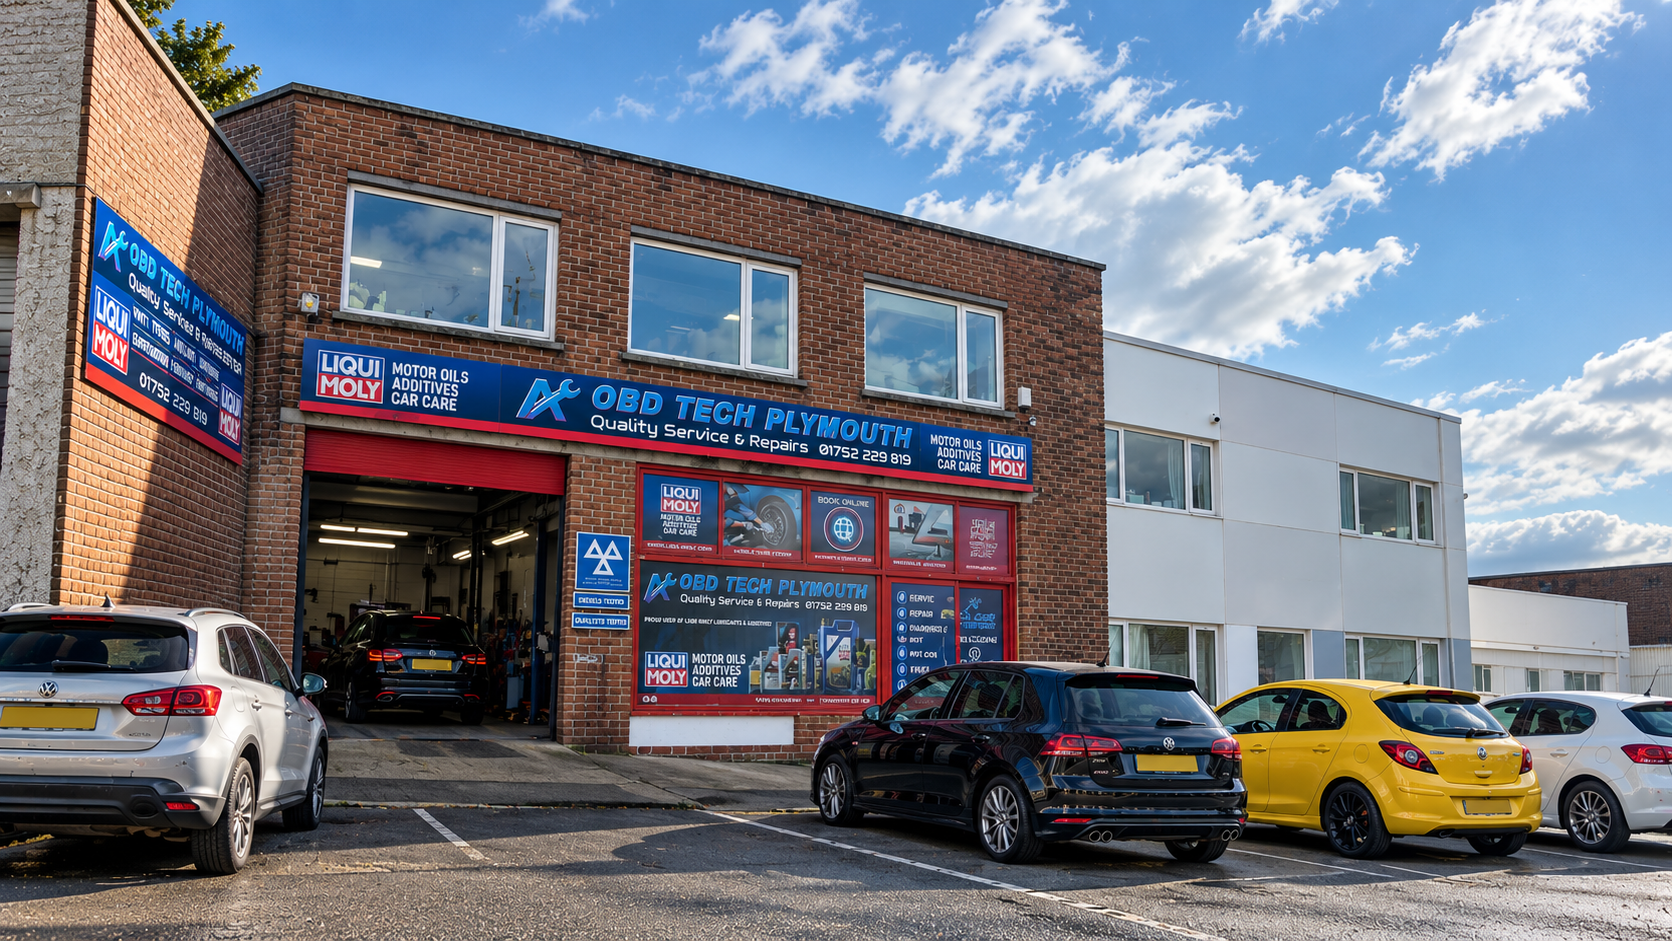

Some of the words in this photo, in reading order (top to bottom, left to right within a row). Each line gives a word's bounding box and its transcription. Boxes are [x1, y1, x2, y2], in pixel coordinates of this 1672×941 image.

[129, 242, 157, 280] OBD
[160, 266, 191, 309] TECH
[192, 295, 245, 356] PLYMOUTH
[96, 291, 128, 338] LIQUI
[94, 323, 127, 369] MOLY
[321, 353, 380, 378] LIQUI
[392, 362, 437, 380] MOTOR
[440, 368, 469, 384] OILS
[139, 372, 170, 403] 01752
[172, 393, 191, 415] 229
[320, 375, 381, 400] MOLY
[391, 377, 459, 397] ADDITIVES
[391, 392, 418, 407] CAR
[422, 395, 458, 412] CARE
[591, 384, 664, 416] OBD
[675, 394, 756, 428] TECH
[764, 407, 913, 449] PLYMOUTH
[590, 414, 658, 439] Quality
[664, 423, 729, 444] Service
[734, 434, 745, 445] &
[749, 434, 809, 453] Repairs
[819, 444, 859, 460] 01752
[862, 449, 888, 463] 229
[890, 453, 912, 466] 819
[930, 434, 961, 447] MOTOR
[963, 438, 982, 450] OILS
[937, 447, 982, 462] ADDITIVES
[990, 442, 1024, 460] LIQUI
[937, 458, 956, 471] CAR
[958, 461, 982, 474] CARE
[990, 459, 1025, 477] MOLY
[663, 486, 699, 500] LIQUI
[817, 496, 840, 505] BOOK
[663, 499, 699, 513] MOLY
[679, 573, 719, 591] OBD
[726, 576, 773, 594] TECH
[778, 579, 868, 599] PLYMOUTH
[718, 595, 754, 606] Service
[805, 600, 832, 611] 01752
[647, 653, 685, 669] LIQUI
[692, 653, 724, 664] MOTOR
[726, 653, 746, 665] OILS
[647, 670, 687, 685] MOLY
[692, 664, 742, 676] ADDITIVES
[692, 676, 711, 687] CAR
[713, 676, 738, 688] CARE
